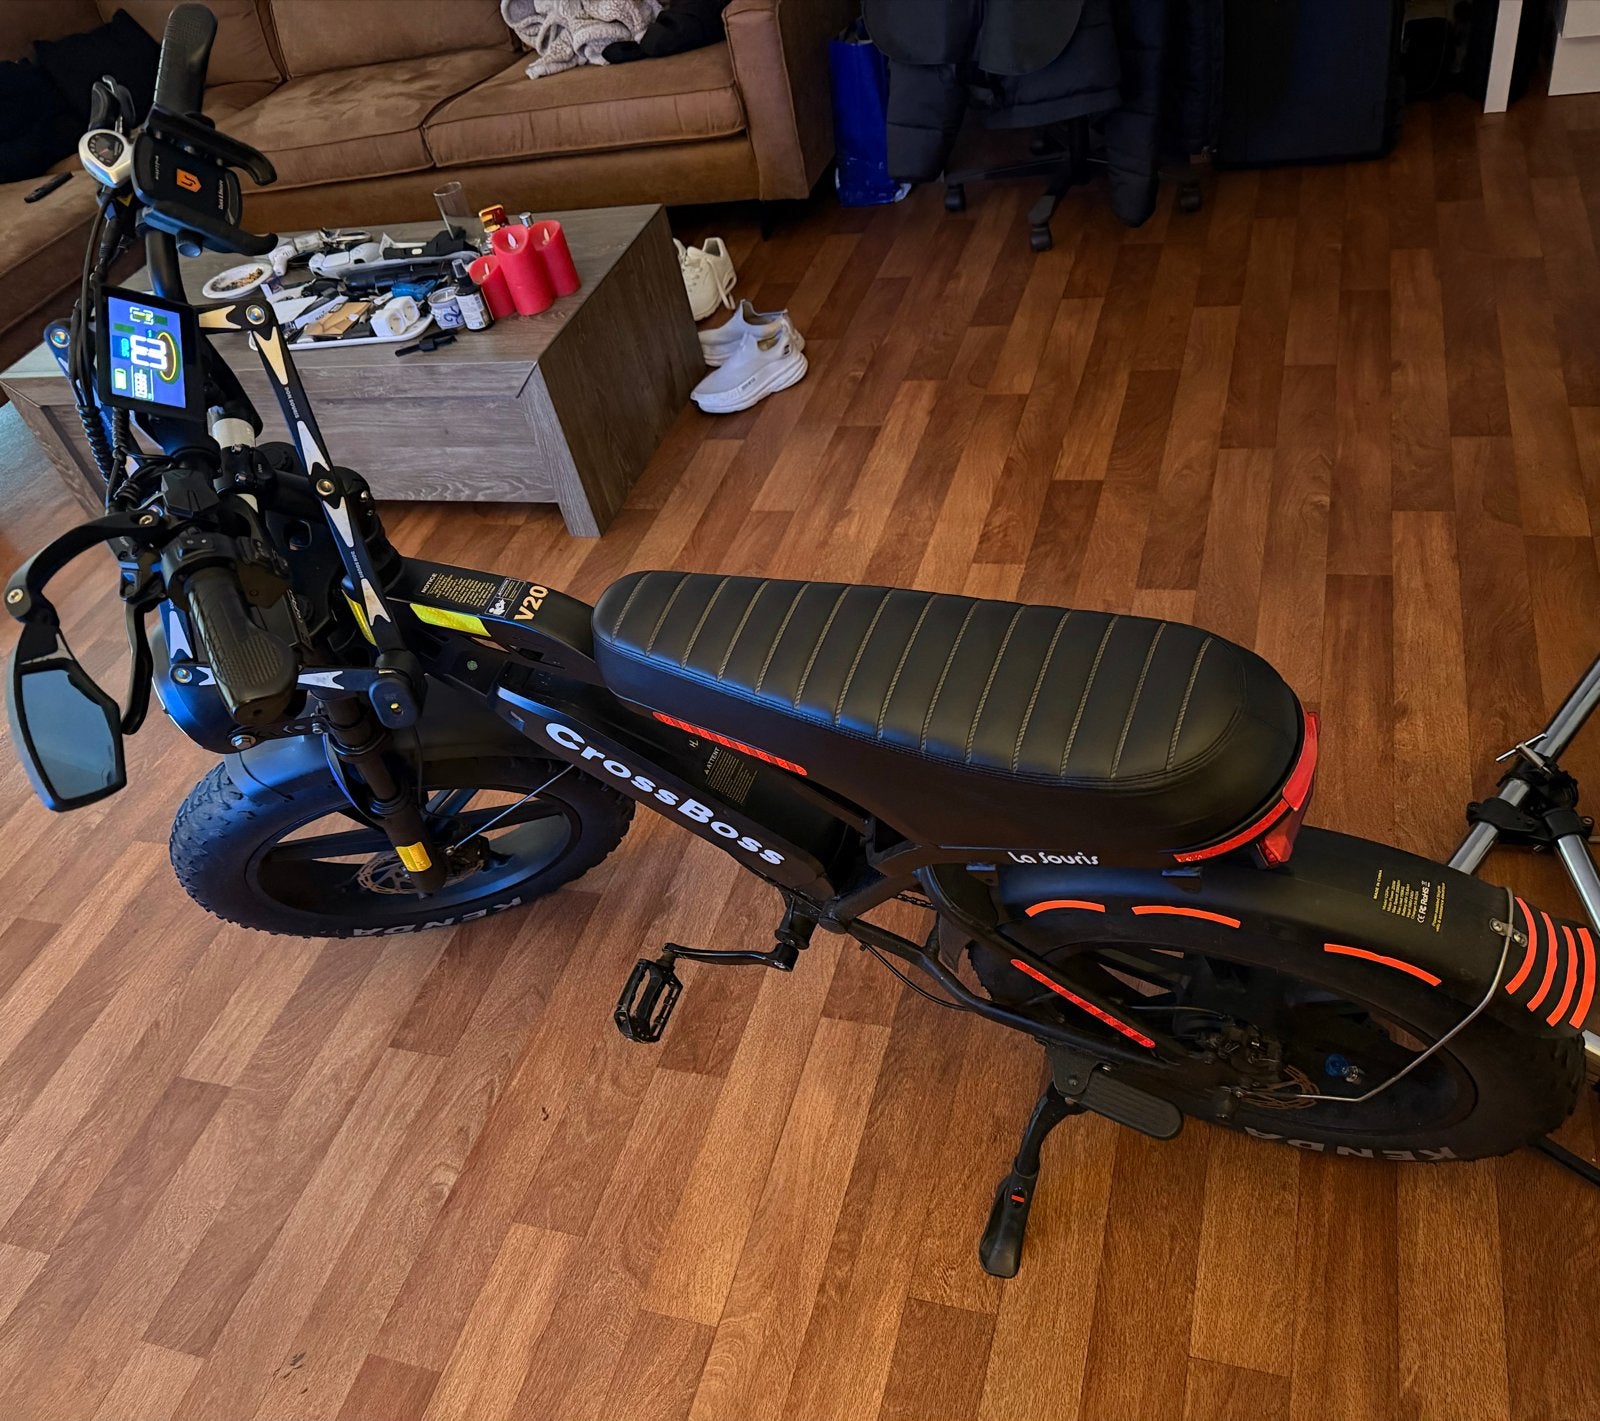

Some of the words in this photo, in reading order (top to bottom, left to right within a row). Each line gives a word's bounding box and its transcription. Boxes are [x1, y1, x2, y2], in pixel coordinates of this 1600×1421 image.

[421, 572, 438, 594] NOTICE
[514, 585, 549, 621] V20
[545, 722, 786, 865] CrossBoss
[1420, 887, 1430, 905] RoHS
[353, 896, 522, 936] KENDA
[1244, 1126, 1458, 1161] KENDA
